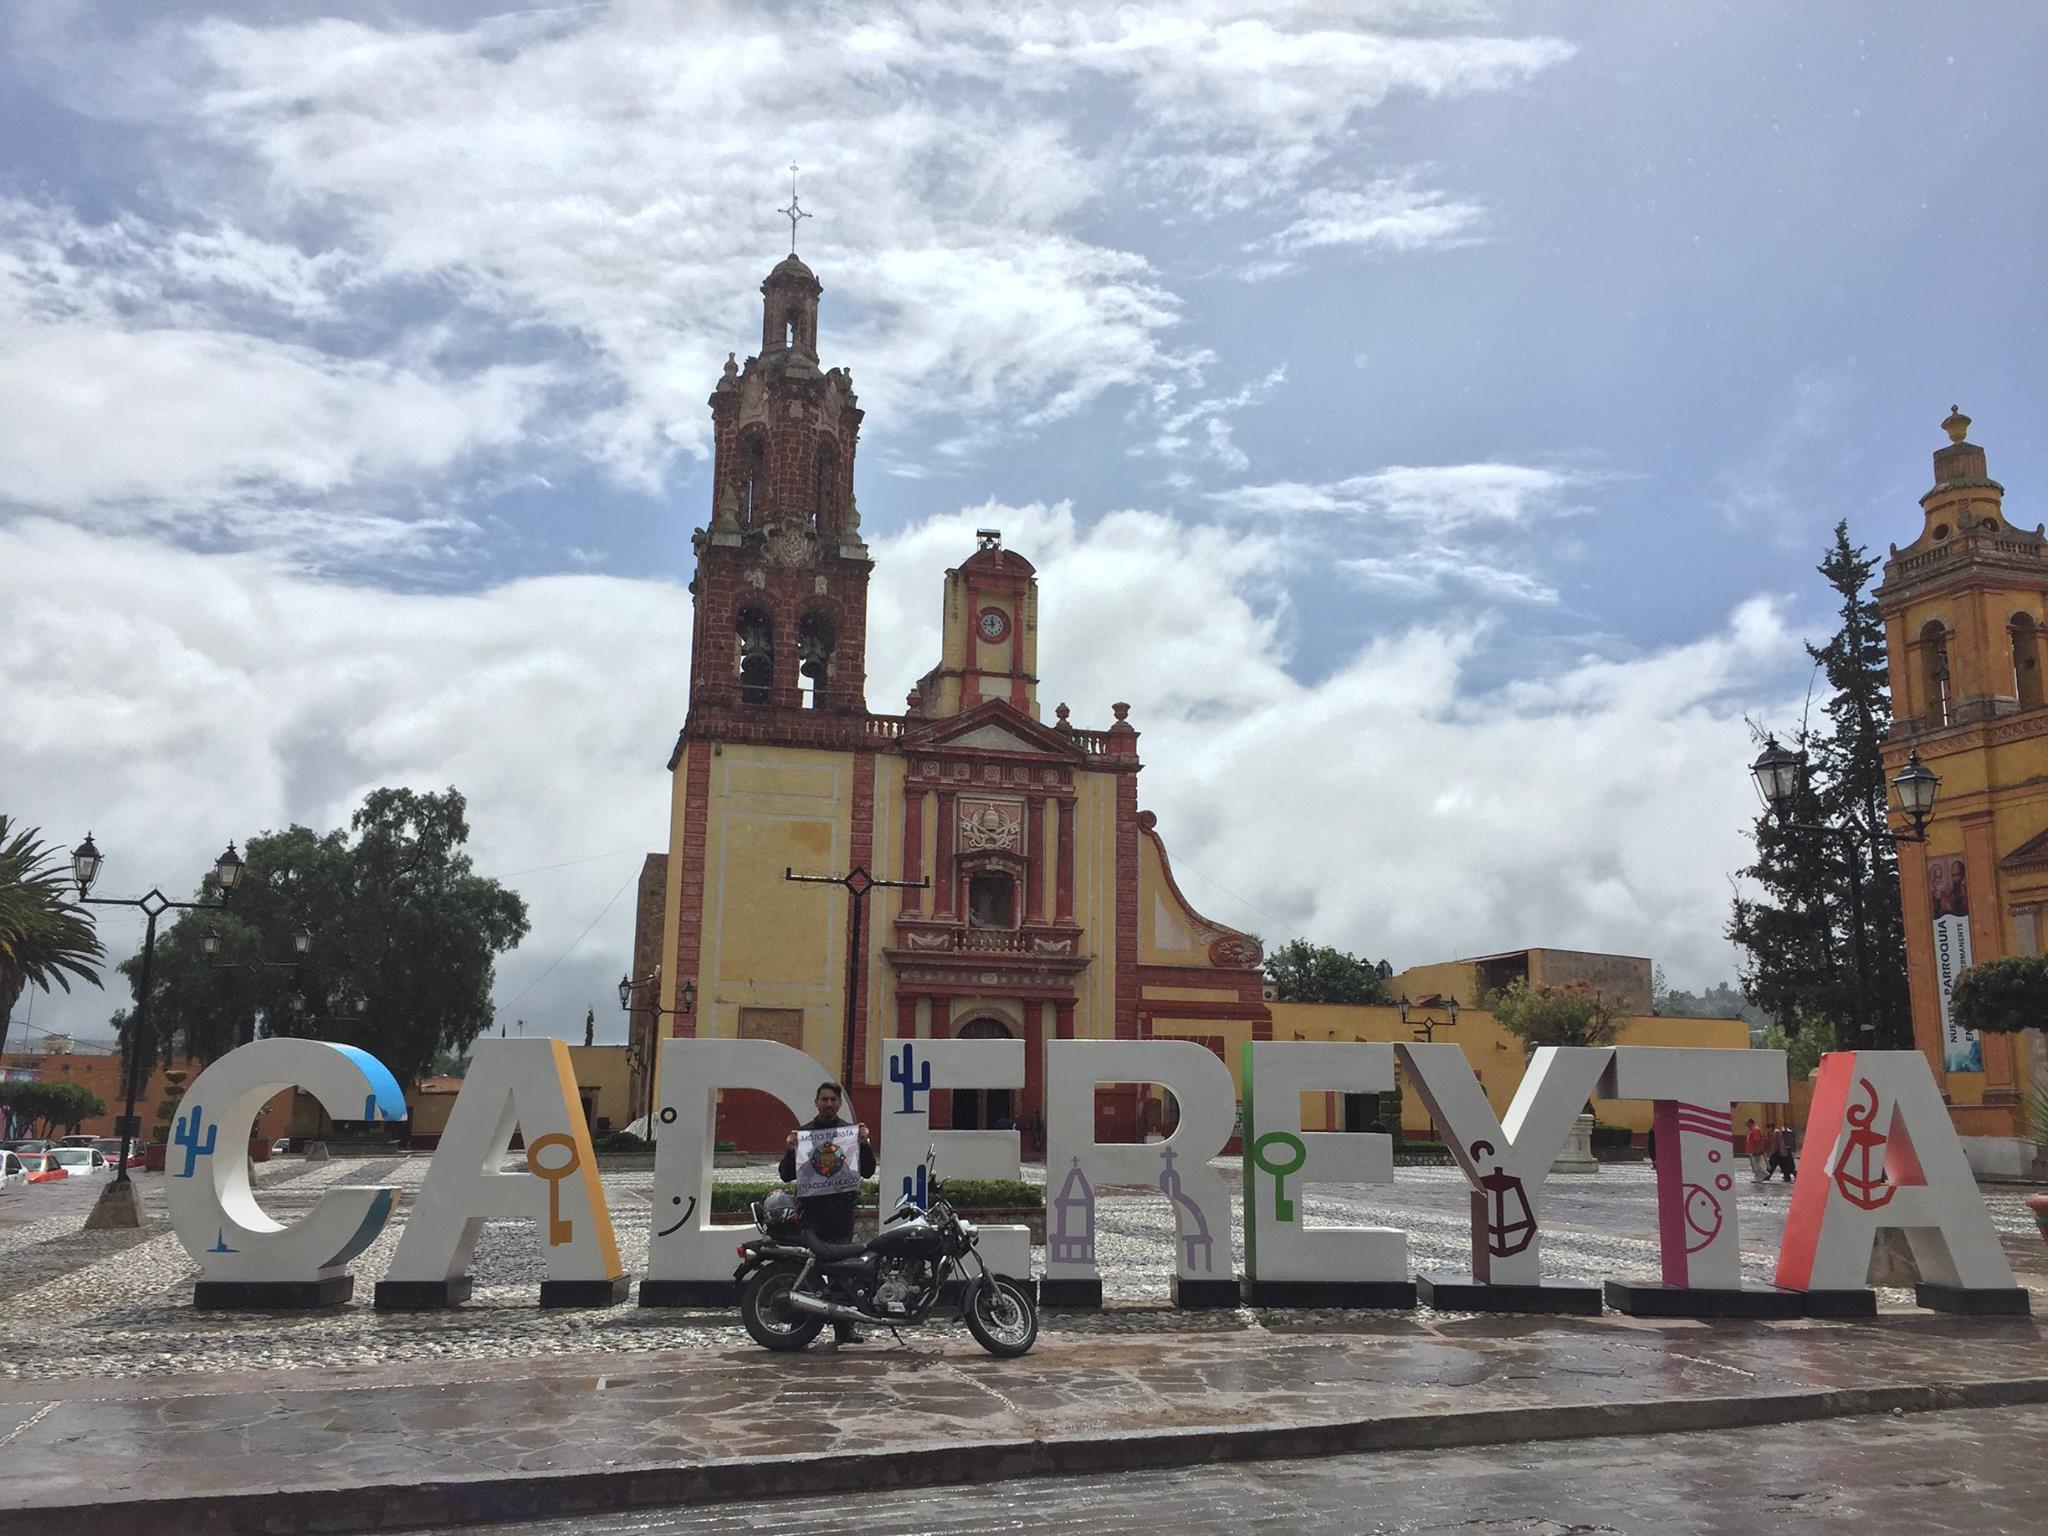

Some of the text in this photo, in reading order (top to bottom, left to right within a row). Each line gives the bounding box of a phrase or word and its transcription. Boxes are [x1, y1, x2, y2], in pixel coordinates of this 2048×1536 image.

[1938, 920, 1953, 996] PARROQUIA
[1957, 922, 1967, 969] ERMANENTE
[164, 1036, 2018, 1294] CADEREYTA
[801, 1130, 854, 1142] MOTO TURISTA
